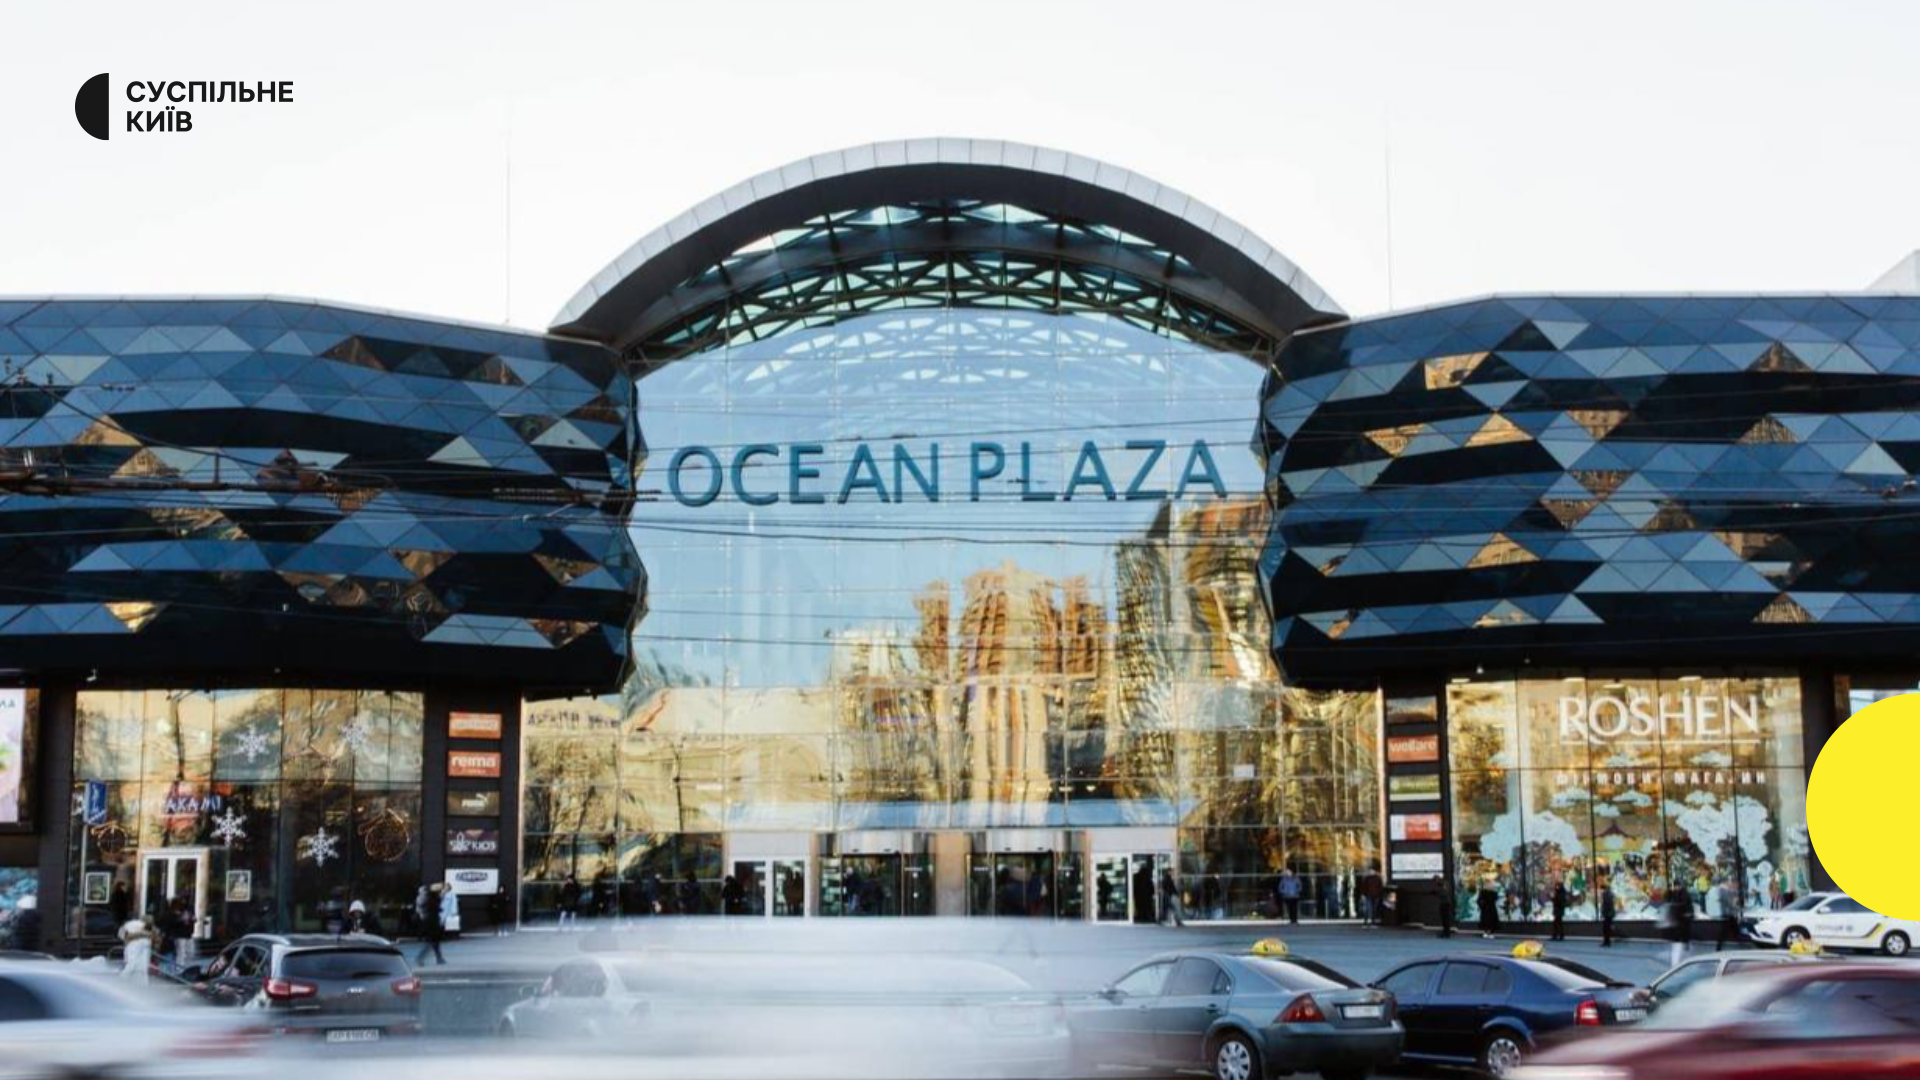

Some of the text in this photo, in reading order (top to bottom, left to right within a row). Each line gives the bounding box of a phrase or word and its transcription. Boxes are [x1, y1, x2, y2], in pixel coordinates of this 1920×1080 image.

[668, 440, 1227, 507] OCEAN PLAZA
[1559, 696, 1760, 745] ROSHEN
[1674, 771, 1766, 786] МАГАИН
